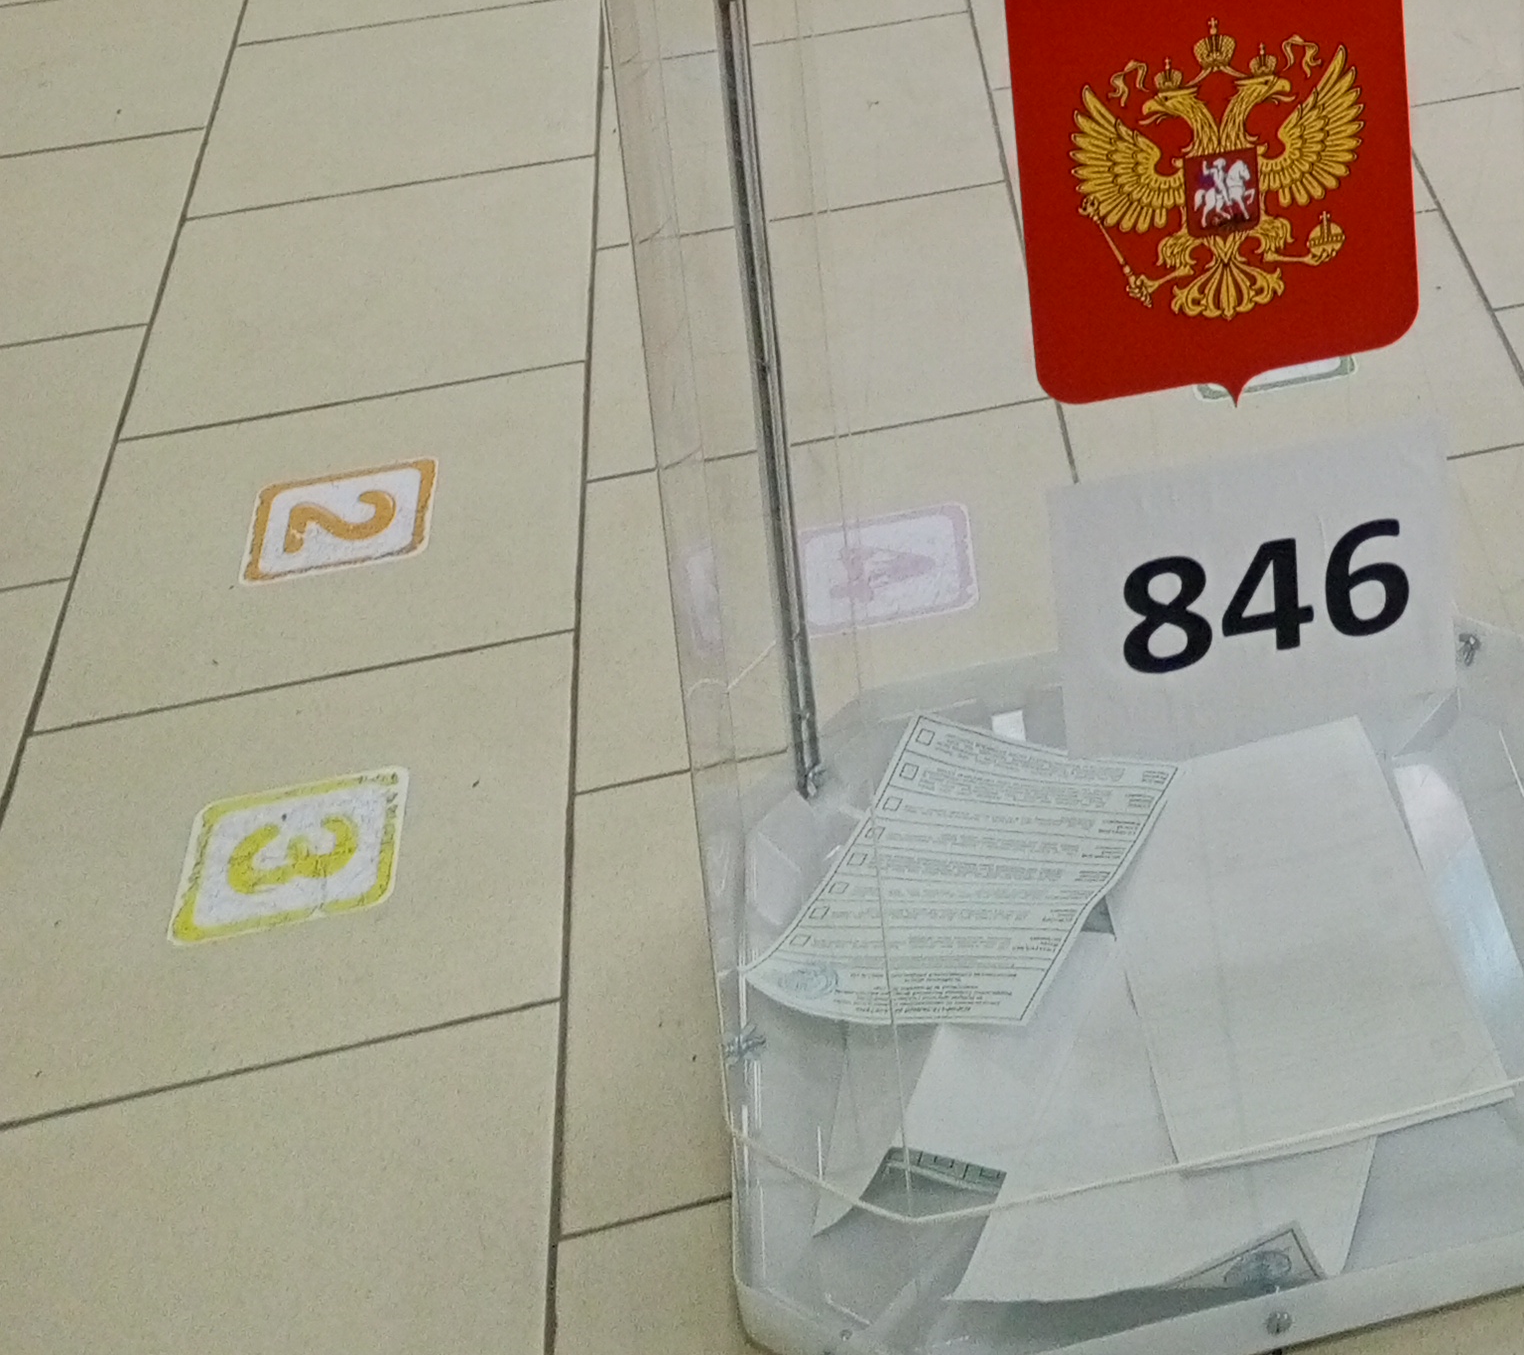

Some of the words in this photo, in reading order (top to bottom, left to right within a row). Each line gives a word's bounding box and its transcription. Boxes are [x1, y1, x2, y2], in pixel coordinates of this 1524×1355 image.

[283, 489, 397, 554] 2
[1122, 518, 1410, 675] 846
[227, 814, 359, 895] 3
